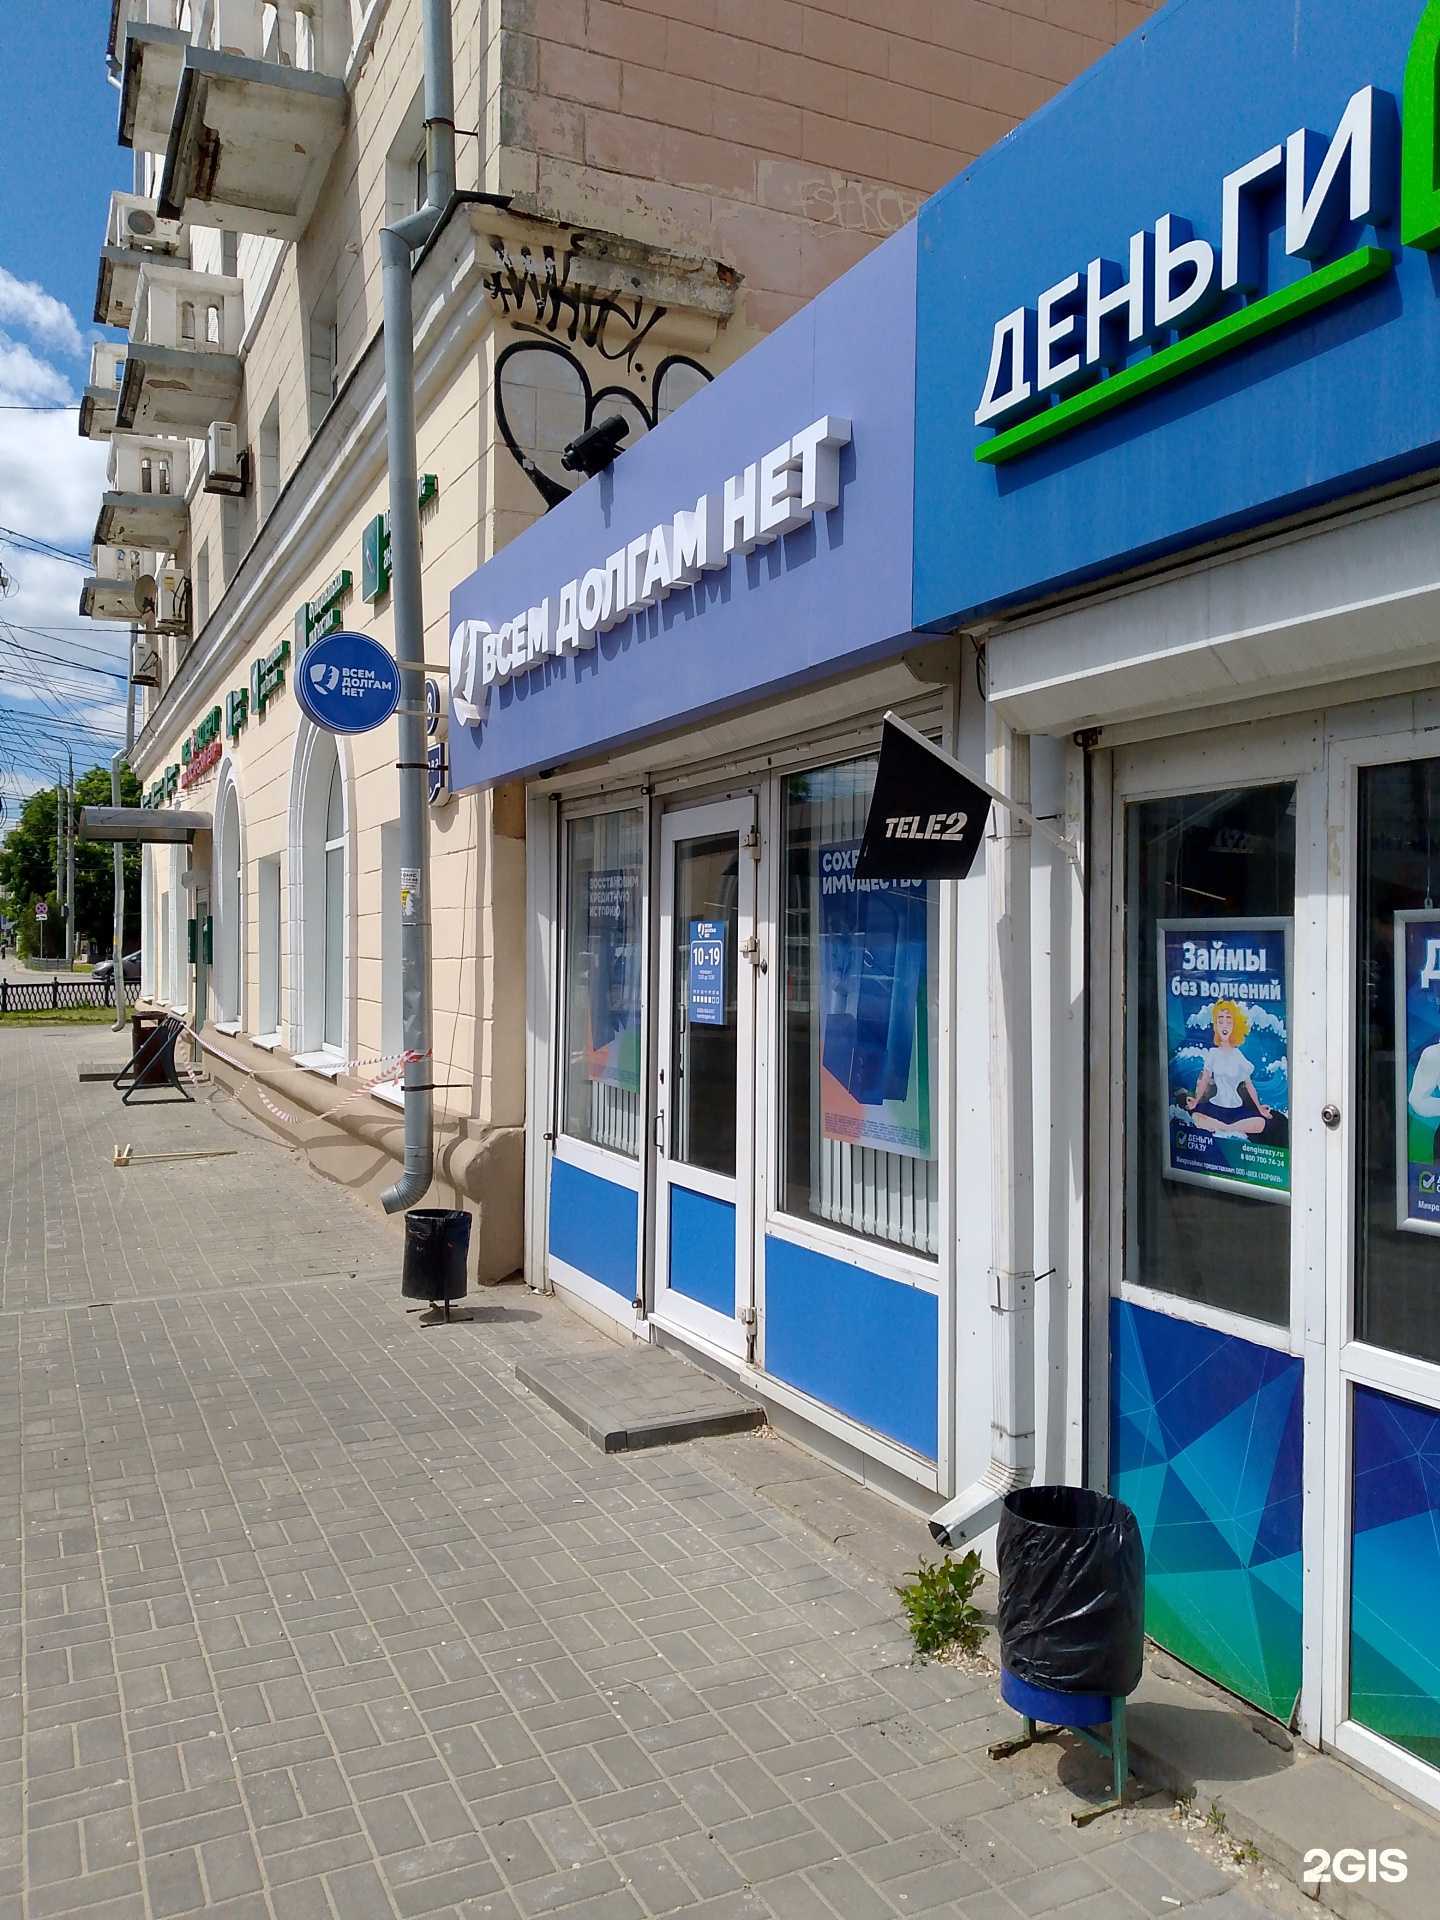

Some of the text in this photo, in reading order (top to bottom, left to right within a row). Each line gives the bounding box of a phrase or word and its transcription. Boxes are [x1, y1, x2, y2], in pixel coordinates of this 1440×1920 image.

[974, 85, 1375, 426] ДЕНЬГИ
[482, 597, 552, 687] ВСЕМ
[556, 495, 714, 656] ДОЛГАМ
[723, 415, 842, 554] НЕТ
[341, 677, 392, 691] ДОЛГАМ
[342, 667, 375, 679] ВСЕМ
[341, 687, 365, 698] НЕТ
[885, 812, 968, 841] TELE2
[822, 849, 861, 873] СОХР
[693, 946, 721, 967] 10-19
[1182, 941, 1267, 972] Займы
[1171, 975, 1281, 1001] без волнений
[1187, 1134, 1213, 1145] ДЕНЬГИ
[1187, 1142, 1207, 1152] СРАЗУ
